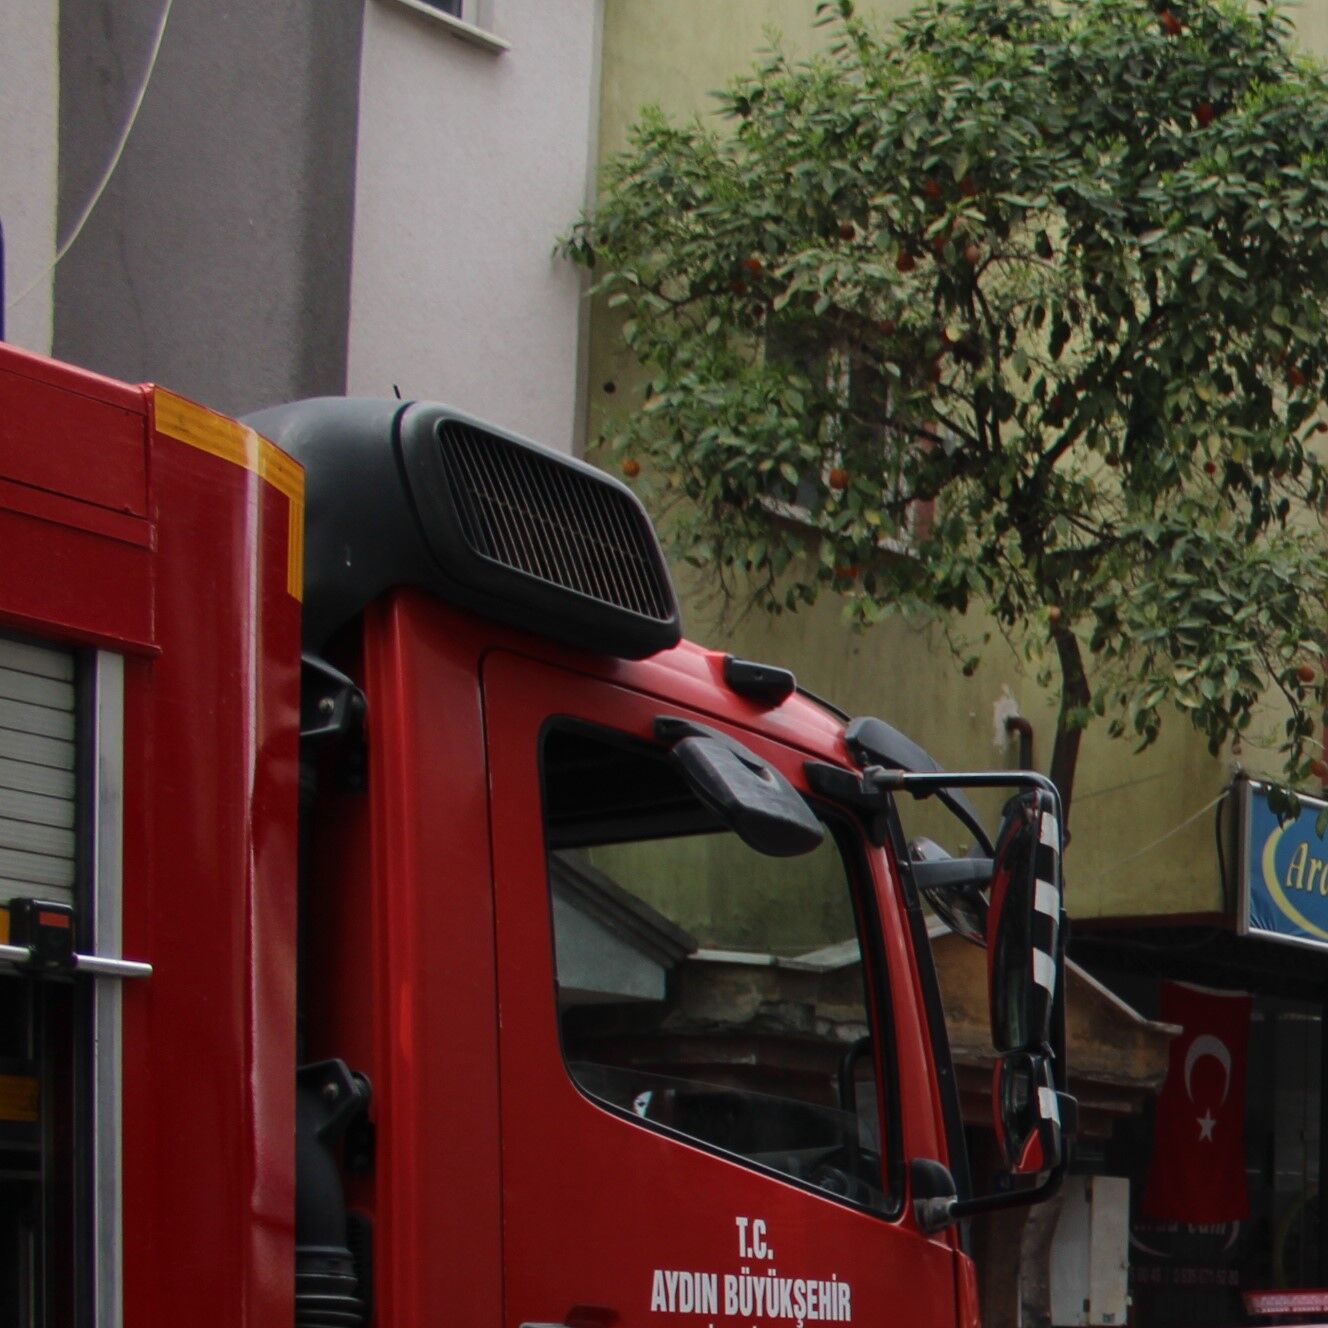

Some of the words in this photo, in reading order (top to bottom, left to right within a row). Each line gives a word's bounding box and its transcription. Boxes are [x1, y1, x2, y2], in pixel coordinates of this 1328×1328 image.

[735, 1216, 774, 1260] T.C.
[650, 1269, 718, 1315] AYDIN
[724, 1266, 852, 1328] BÜYÜKŞEHİR
